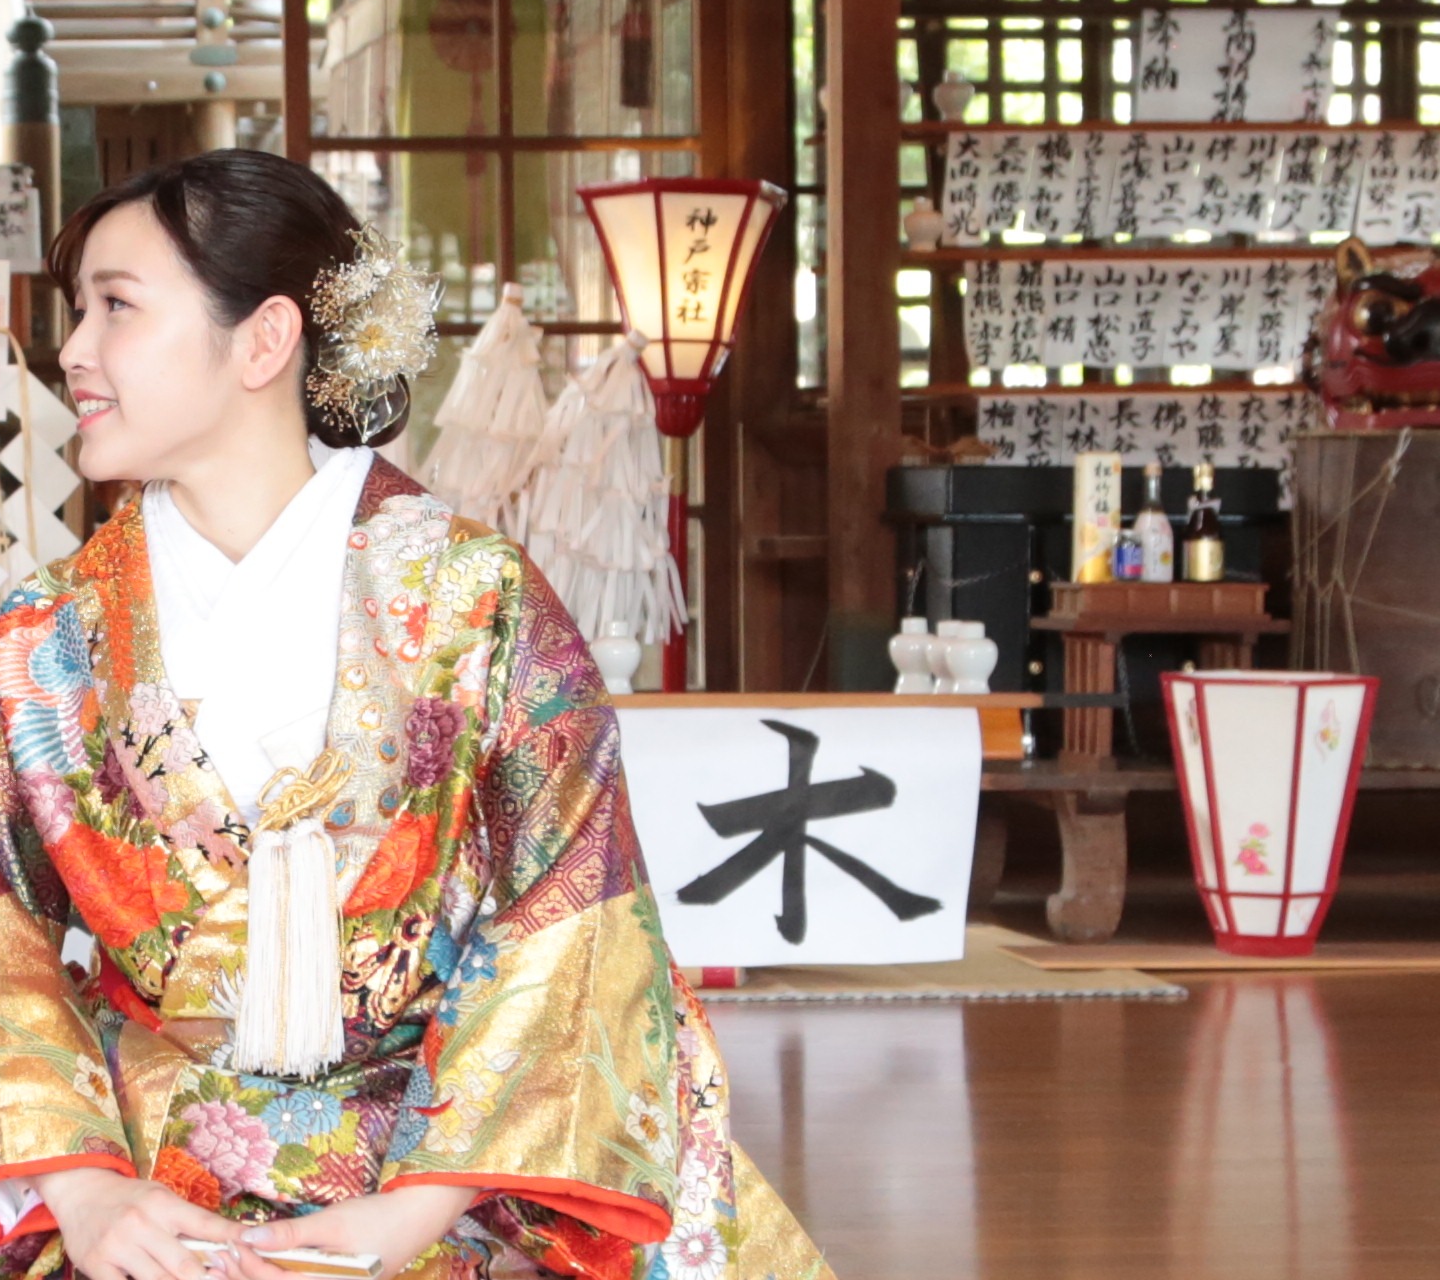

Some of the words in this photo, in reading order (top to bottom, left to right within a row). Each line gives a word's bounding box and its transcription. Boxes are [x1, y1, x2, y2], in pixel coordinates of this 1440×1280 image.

[675, 207, 720, 325] 神戸宗社
[674, 718, 946, 947] 木
